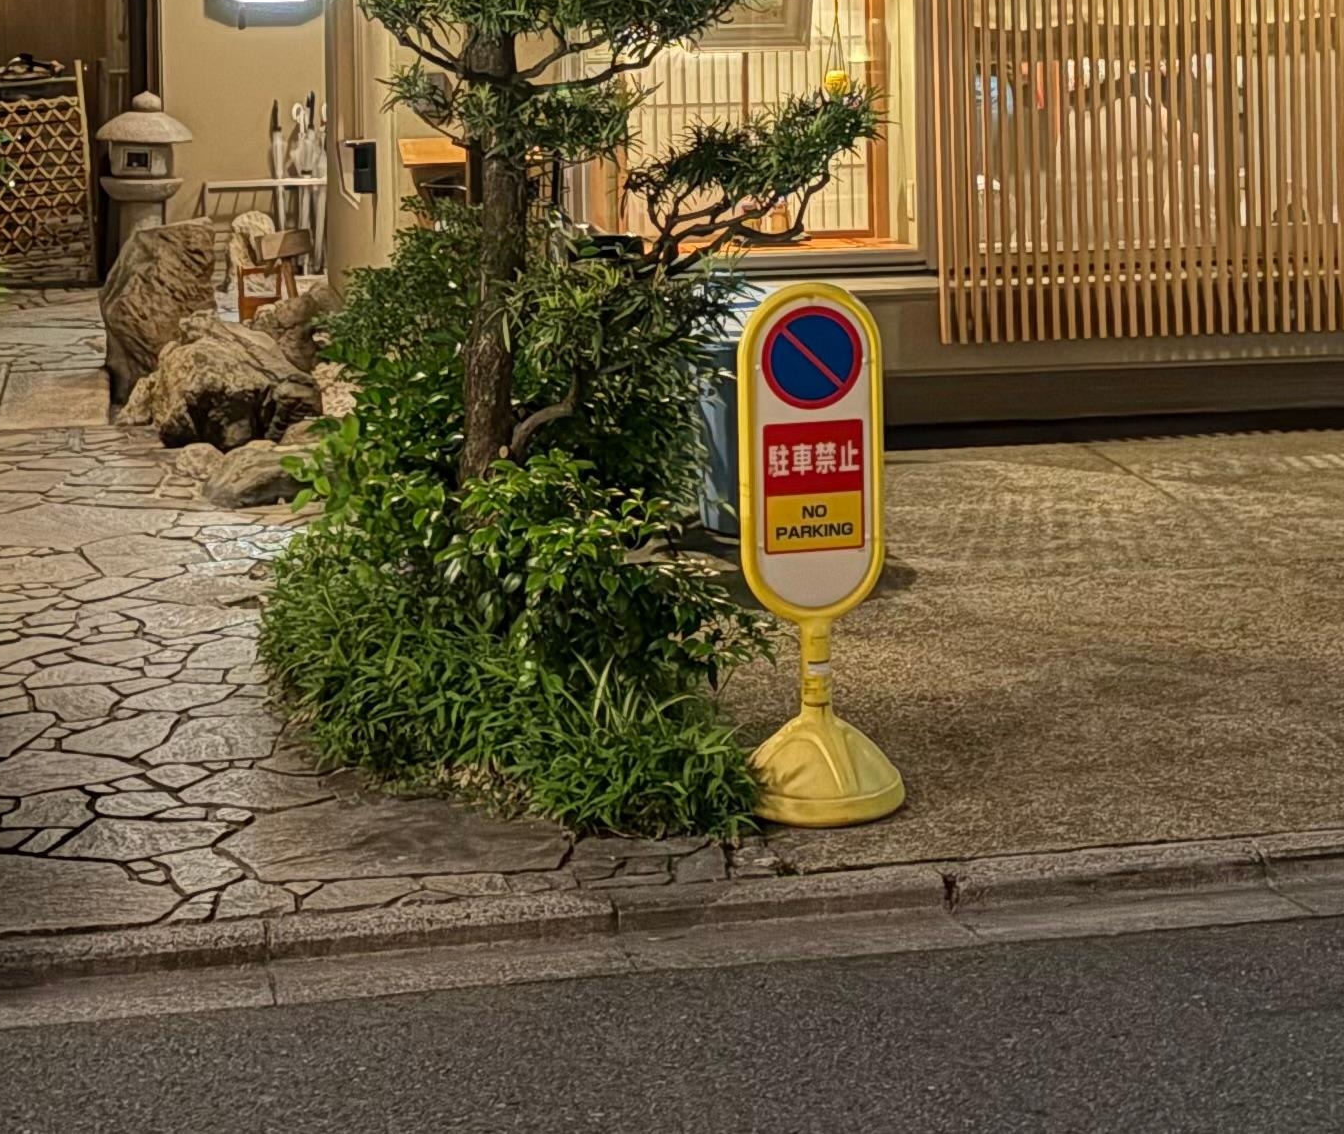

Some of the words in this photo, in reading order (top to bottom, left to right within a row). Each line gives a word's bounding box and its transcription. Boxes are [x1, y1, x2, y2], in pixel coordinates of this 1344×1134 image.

[768, 439, 860, 478] 駐車禁止
[802, 504, 828, 519] NO
[775, 522, 854, 540] PARKING
